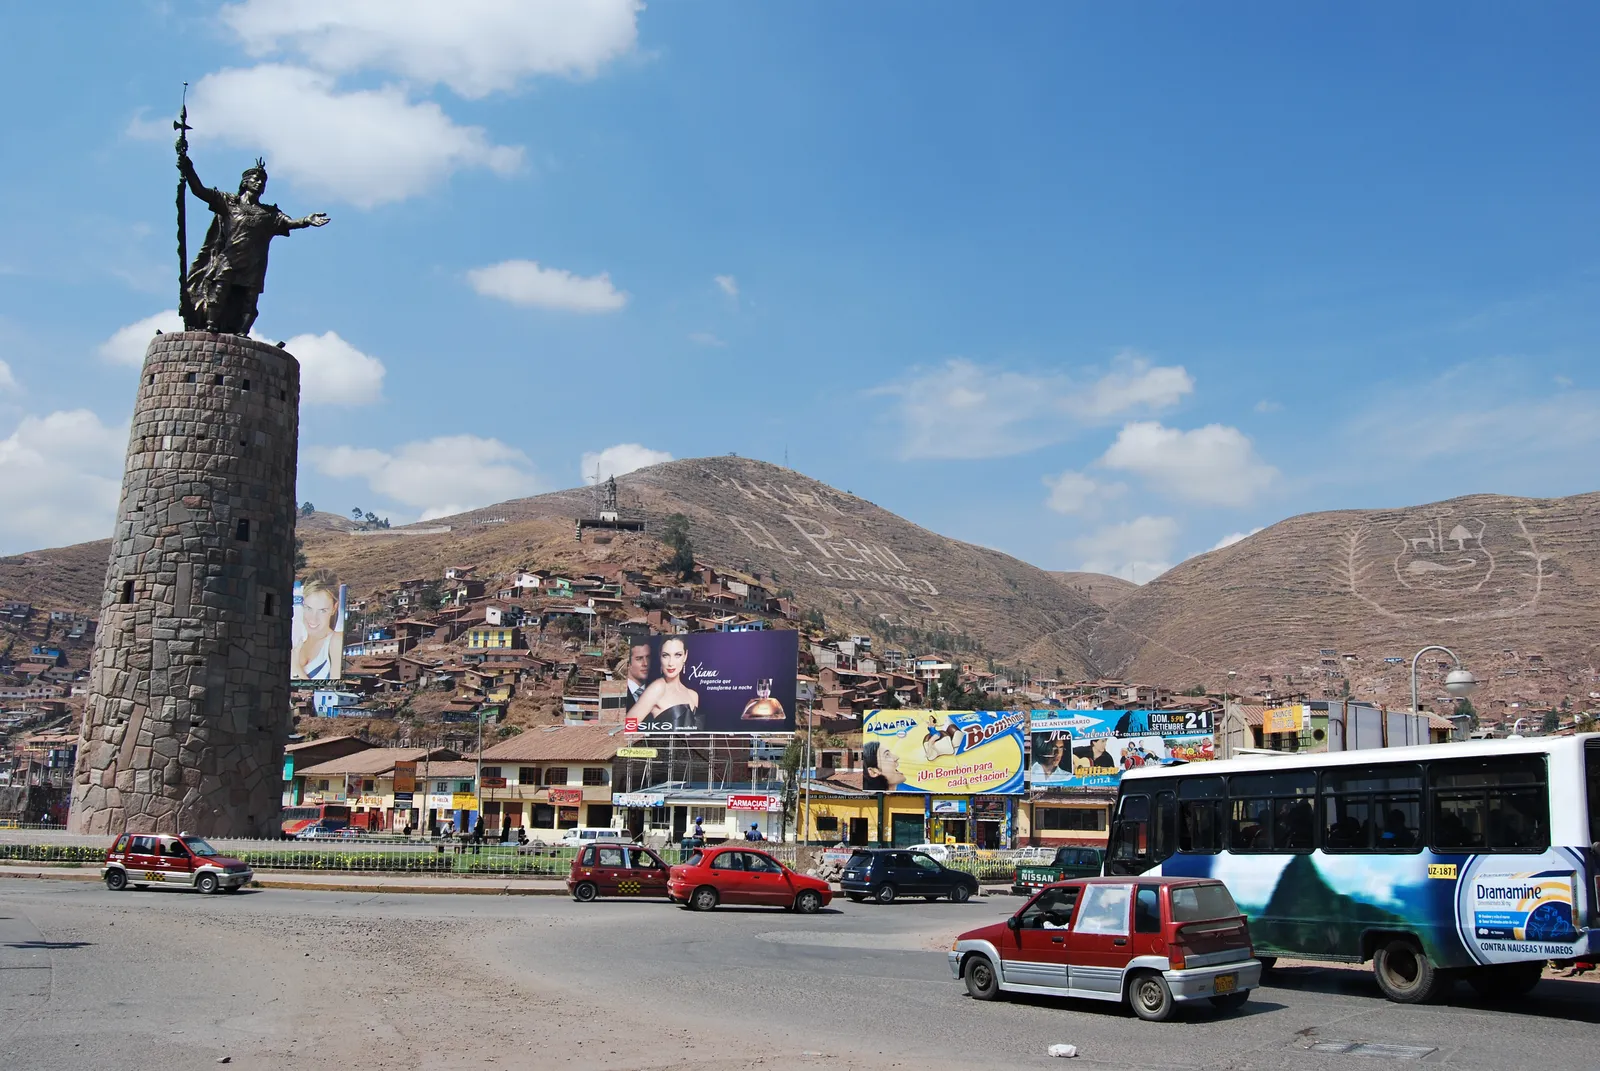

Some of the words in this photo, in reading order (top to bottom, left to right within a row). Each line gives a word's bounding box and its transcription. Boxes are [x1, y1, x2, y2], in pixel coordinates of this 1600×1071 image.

[689, 662, 719, 681] Xiana
[1152, 714, 1169, 723] DOM.
[1185, 711, 1207, 729] 21
[1152, 722, 1184, 731] SETIEMBRE
[974, 761, 993, 773] para
[947, 777, 968, 788] cada
[1082, 775, 1111, 786] Luna
[728, 796, 768, 807] FARMACIAS
[1428, 866, 1457, 877] UZ-1871
[1021, 872, 1054, 883] NISSAN
[1477, 884, 1542, 900] Dramamine
[1480, 942, 1506, 952] CONTRA
[1507, 943, 1537, 953] NAUSEAS
[1538, 945, 1544, 953] Y
[1544, 945, 1574, 955] MAREOS
